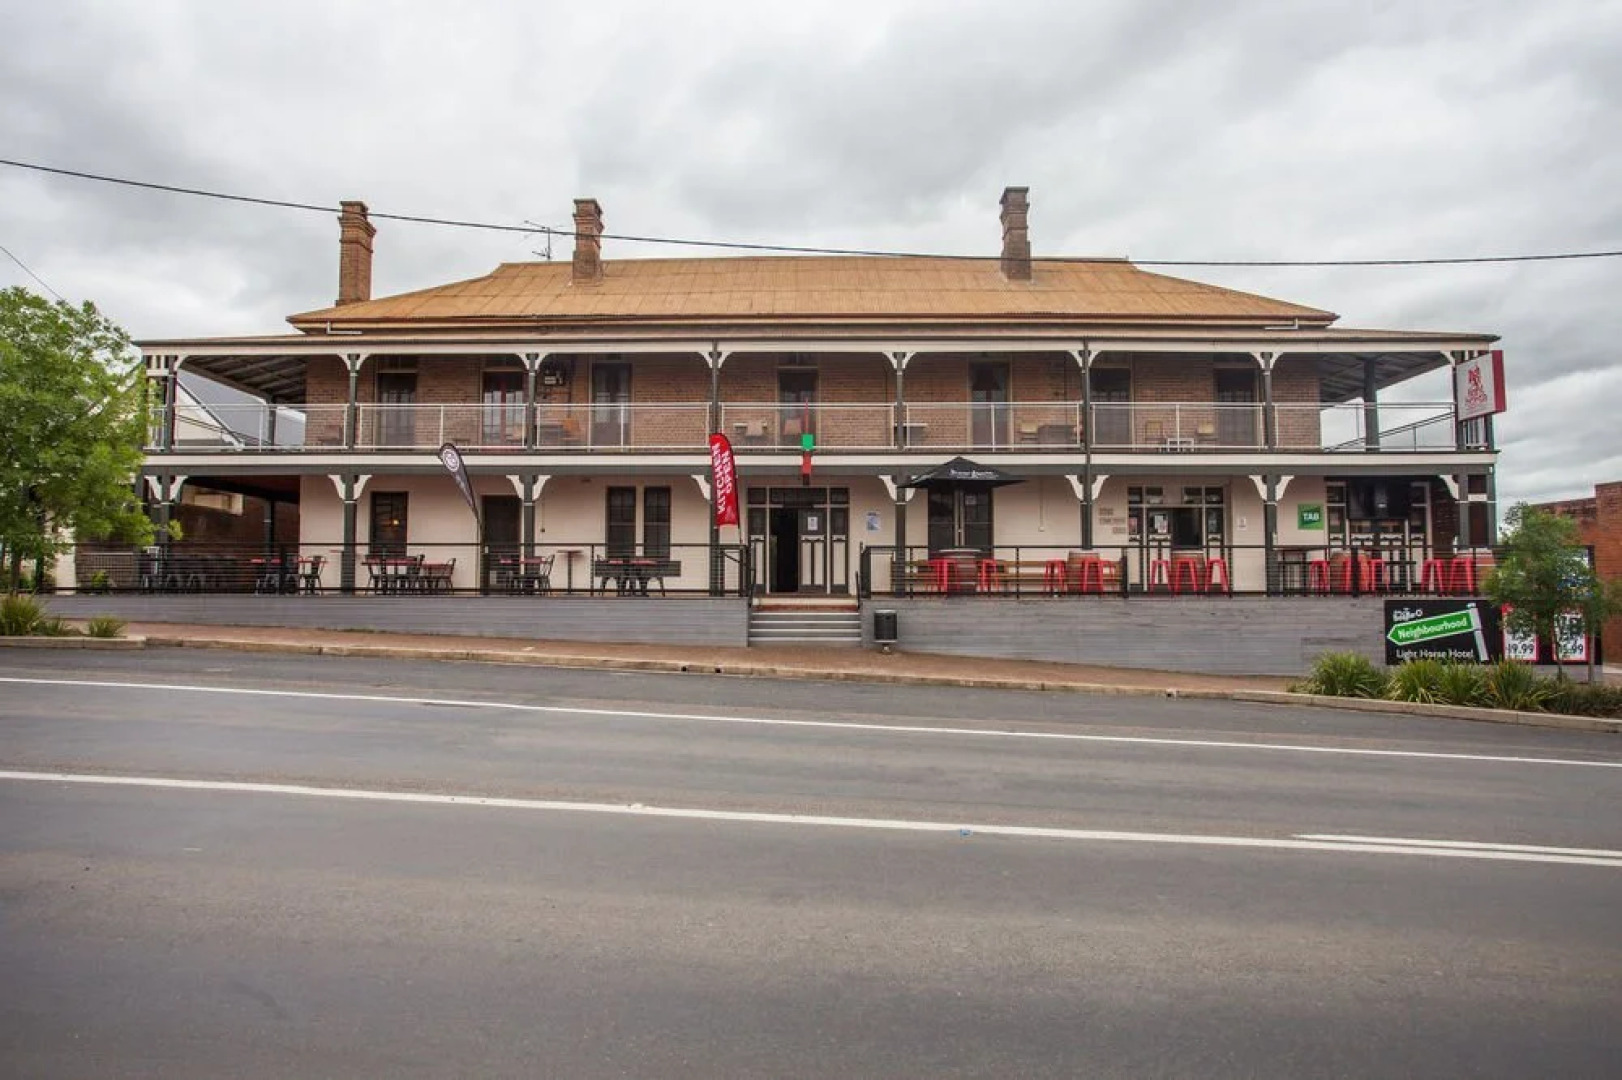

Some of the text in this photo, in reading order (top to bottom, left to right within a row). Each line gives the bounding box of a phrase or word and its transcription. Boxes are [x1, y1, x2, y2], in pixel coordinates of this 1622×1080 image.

[711, 442, 726, 515] KITCHEN
[722, 450, 732, 494] OPEN
[1302, 512, 1320, 522] TAB
[1397, 617, 1468, 640] Neighbourhood
[1396, 649, 1417, 661] Light
[1449, 648, 1474, 659] Hotel
[1507, 643, 1535, 654] 19.99
